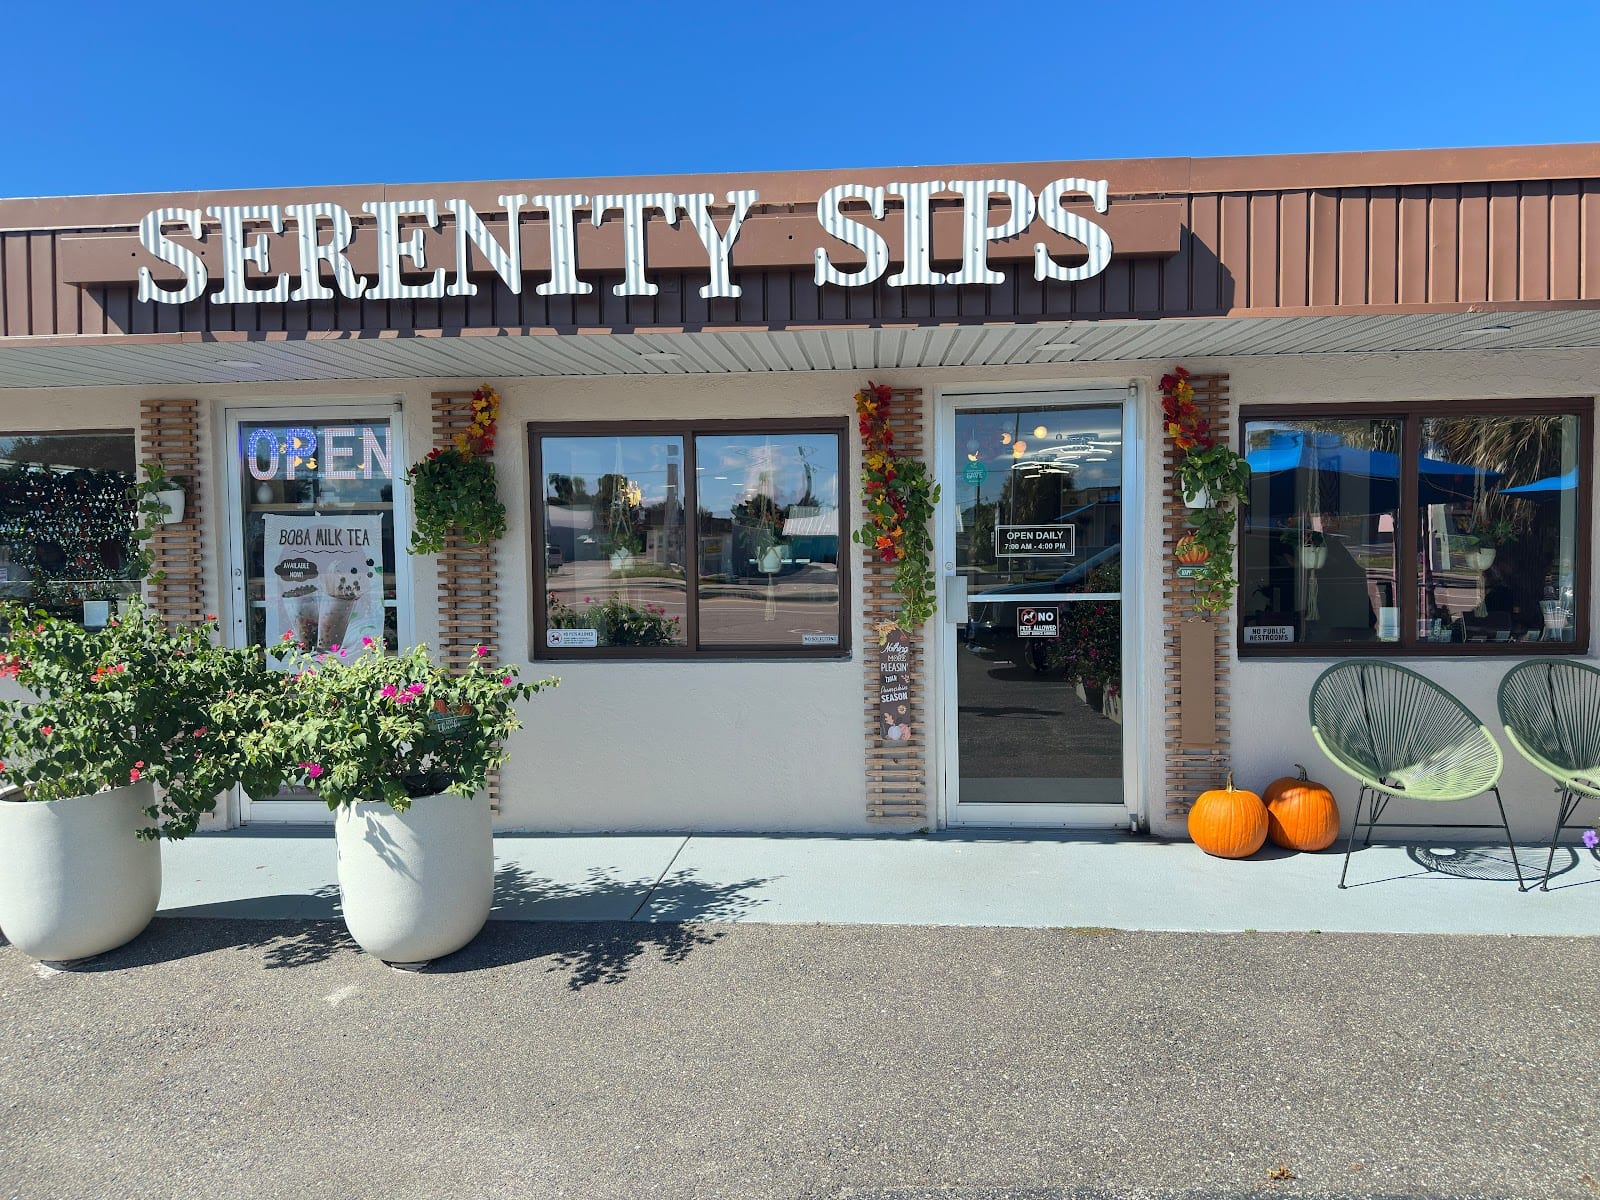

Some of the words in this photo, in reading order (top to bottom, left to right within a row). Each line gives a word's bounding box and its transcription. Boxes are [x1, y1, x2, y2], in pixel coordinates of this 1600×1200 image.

[137, 190, 760, 304] SERENITY
[814, 177, 1113, 288] SIPS
[248, 427, 393, 481] OPEN
[279, 529, 312, 546] BOBA
[315, 529, 342, 546] MILK
[346, 529, 370, 546] TEA
[1006, 531, 1034, 540] OPEN
[1036, 531, 1064, 540] DAILY
[1038, 612, 1054, 622] NO
[880, 642, 908, 655] Nothing
[881, 662, 908, 672] PLEASIN'
[881, 692, 908, 702] SEASON
